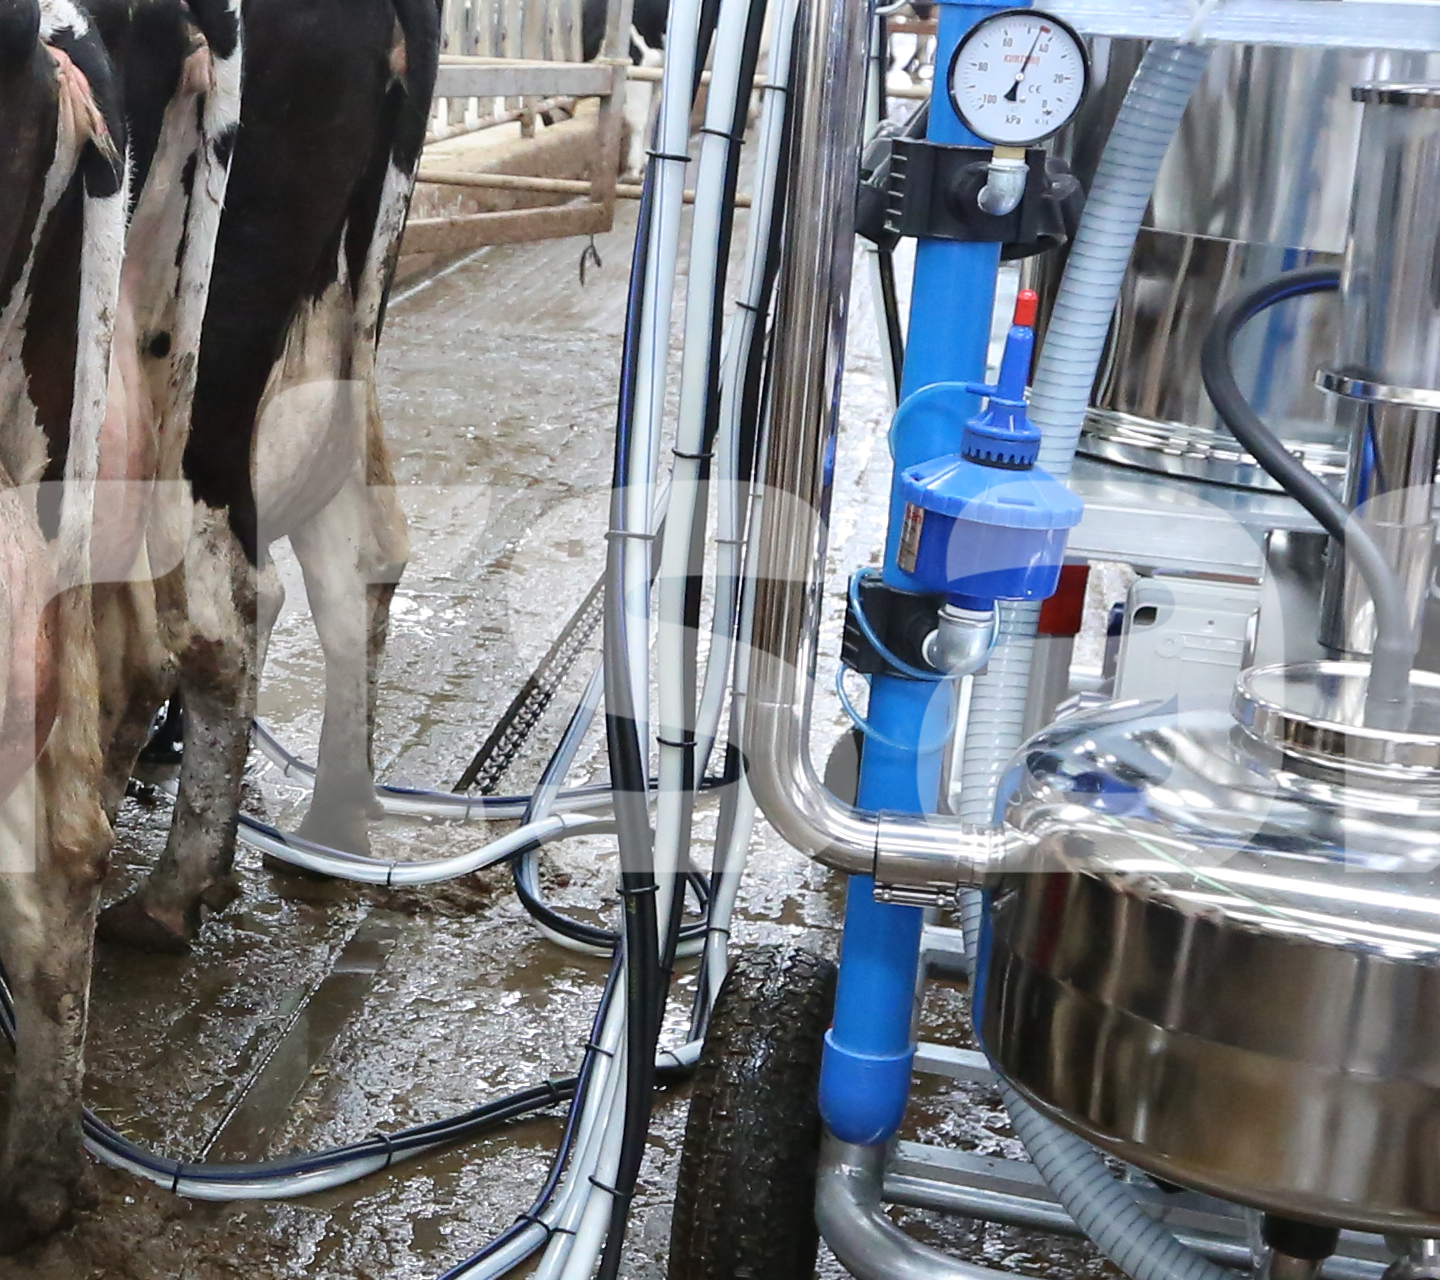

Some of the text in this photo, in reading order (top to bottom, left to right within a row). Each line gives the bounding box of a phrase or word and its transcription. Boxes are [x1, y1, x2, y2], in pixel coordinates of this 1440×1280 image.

[1039, 43, 1049, 53] 40
[1053, 74, 1064, 84] 20
[983, 94, 997, 104] 100
[1005, 115, 1022, 125] kPa
